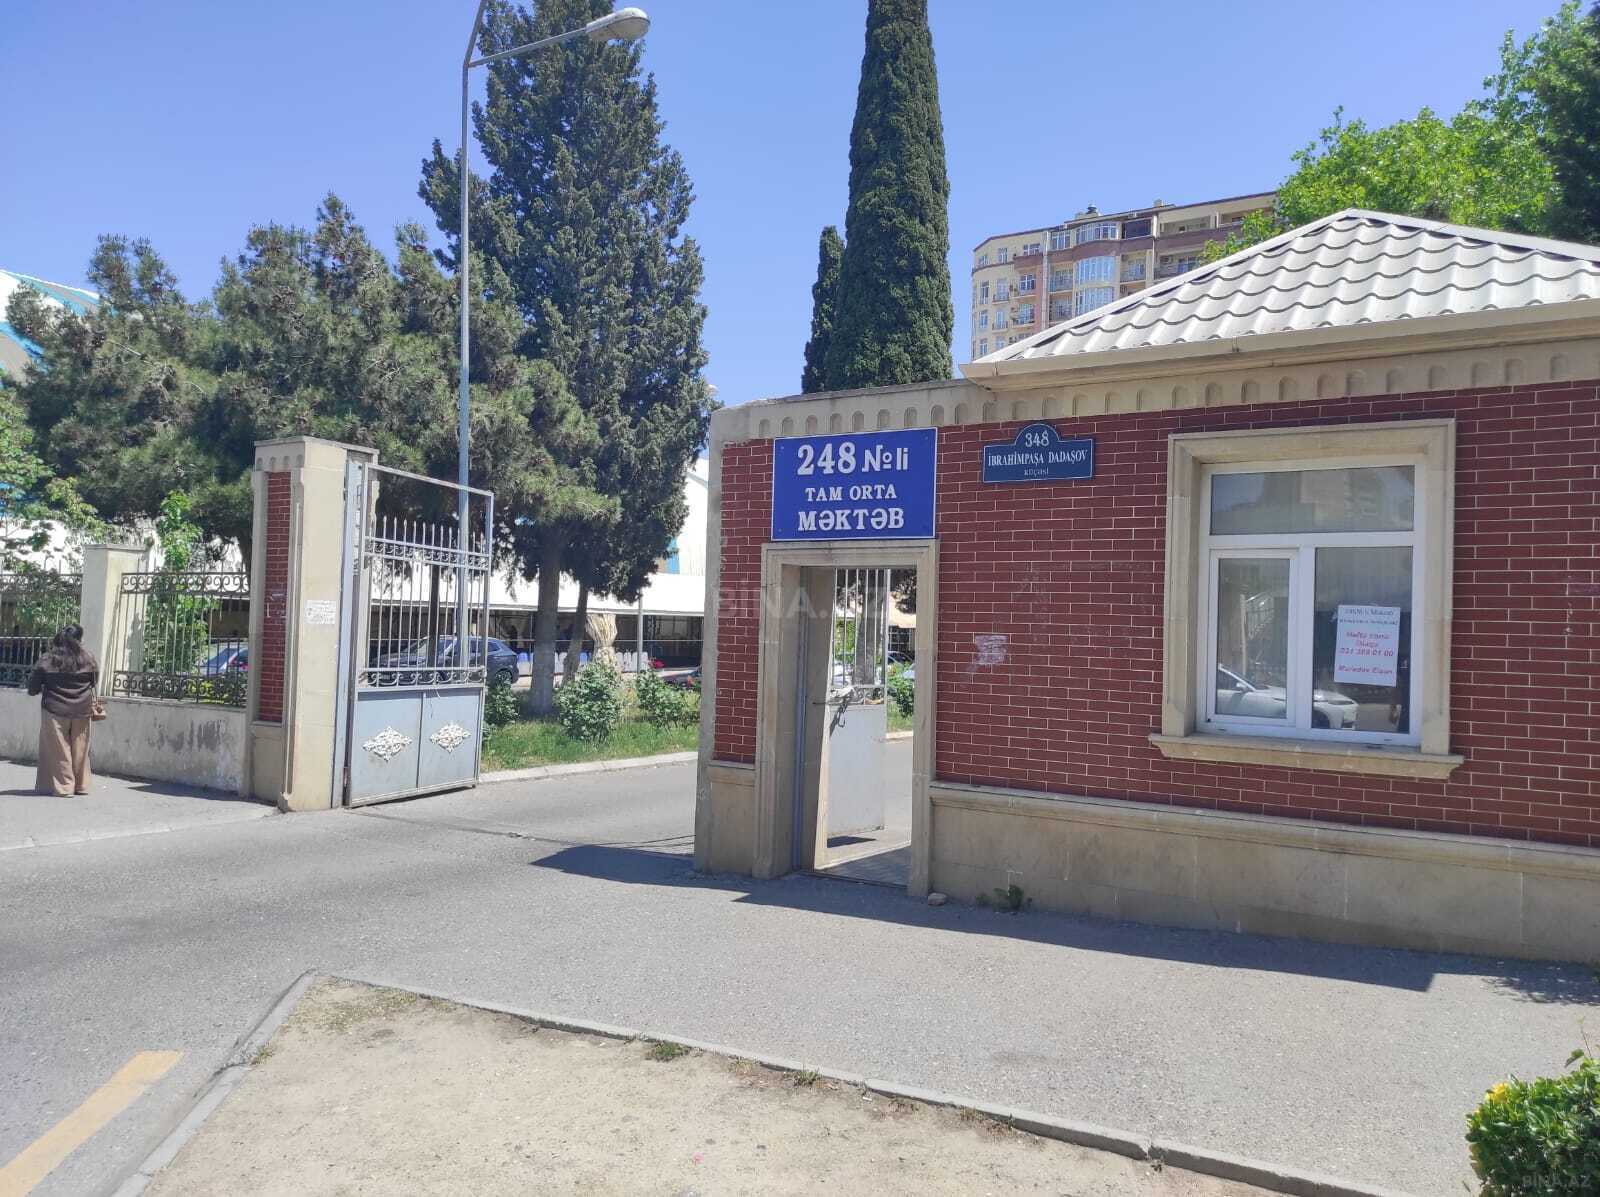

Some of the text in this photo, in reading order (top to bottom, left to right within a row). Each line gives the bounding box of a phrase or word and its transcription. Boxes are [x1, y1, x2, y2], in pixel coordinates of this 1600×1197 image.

[1025, 429, 1050, 448] 348
[797, 441, 856, 476] 248
[988, 449, 1089, 467] İBRAHİMPAŞA DADAŞOV
[805, 483, 897, 502] TAM ORTA
[797, 507, 905, 532] MƏKTƏB
